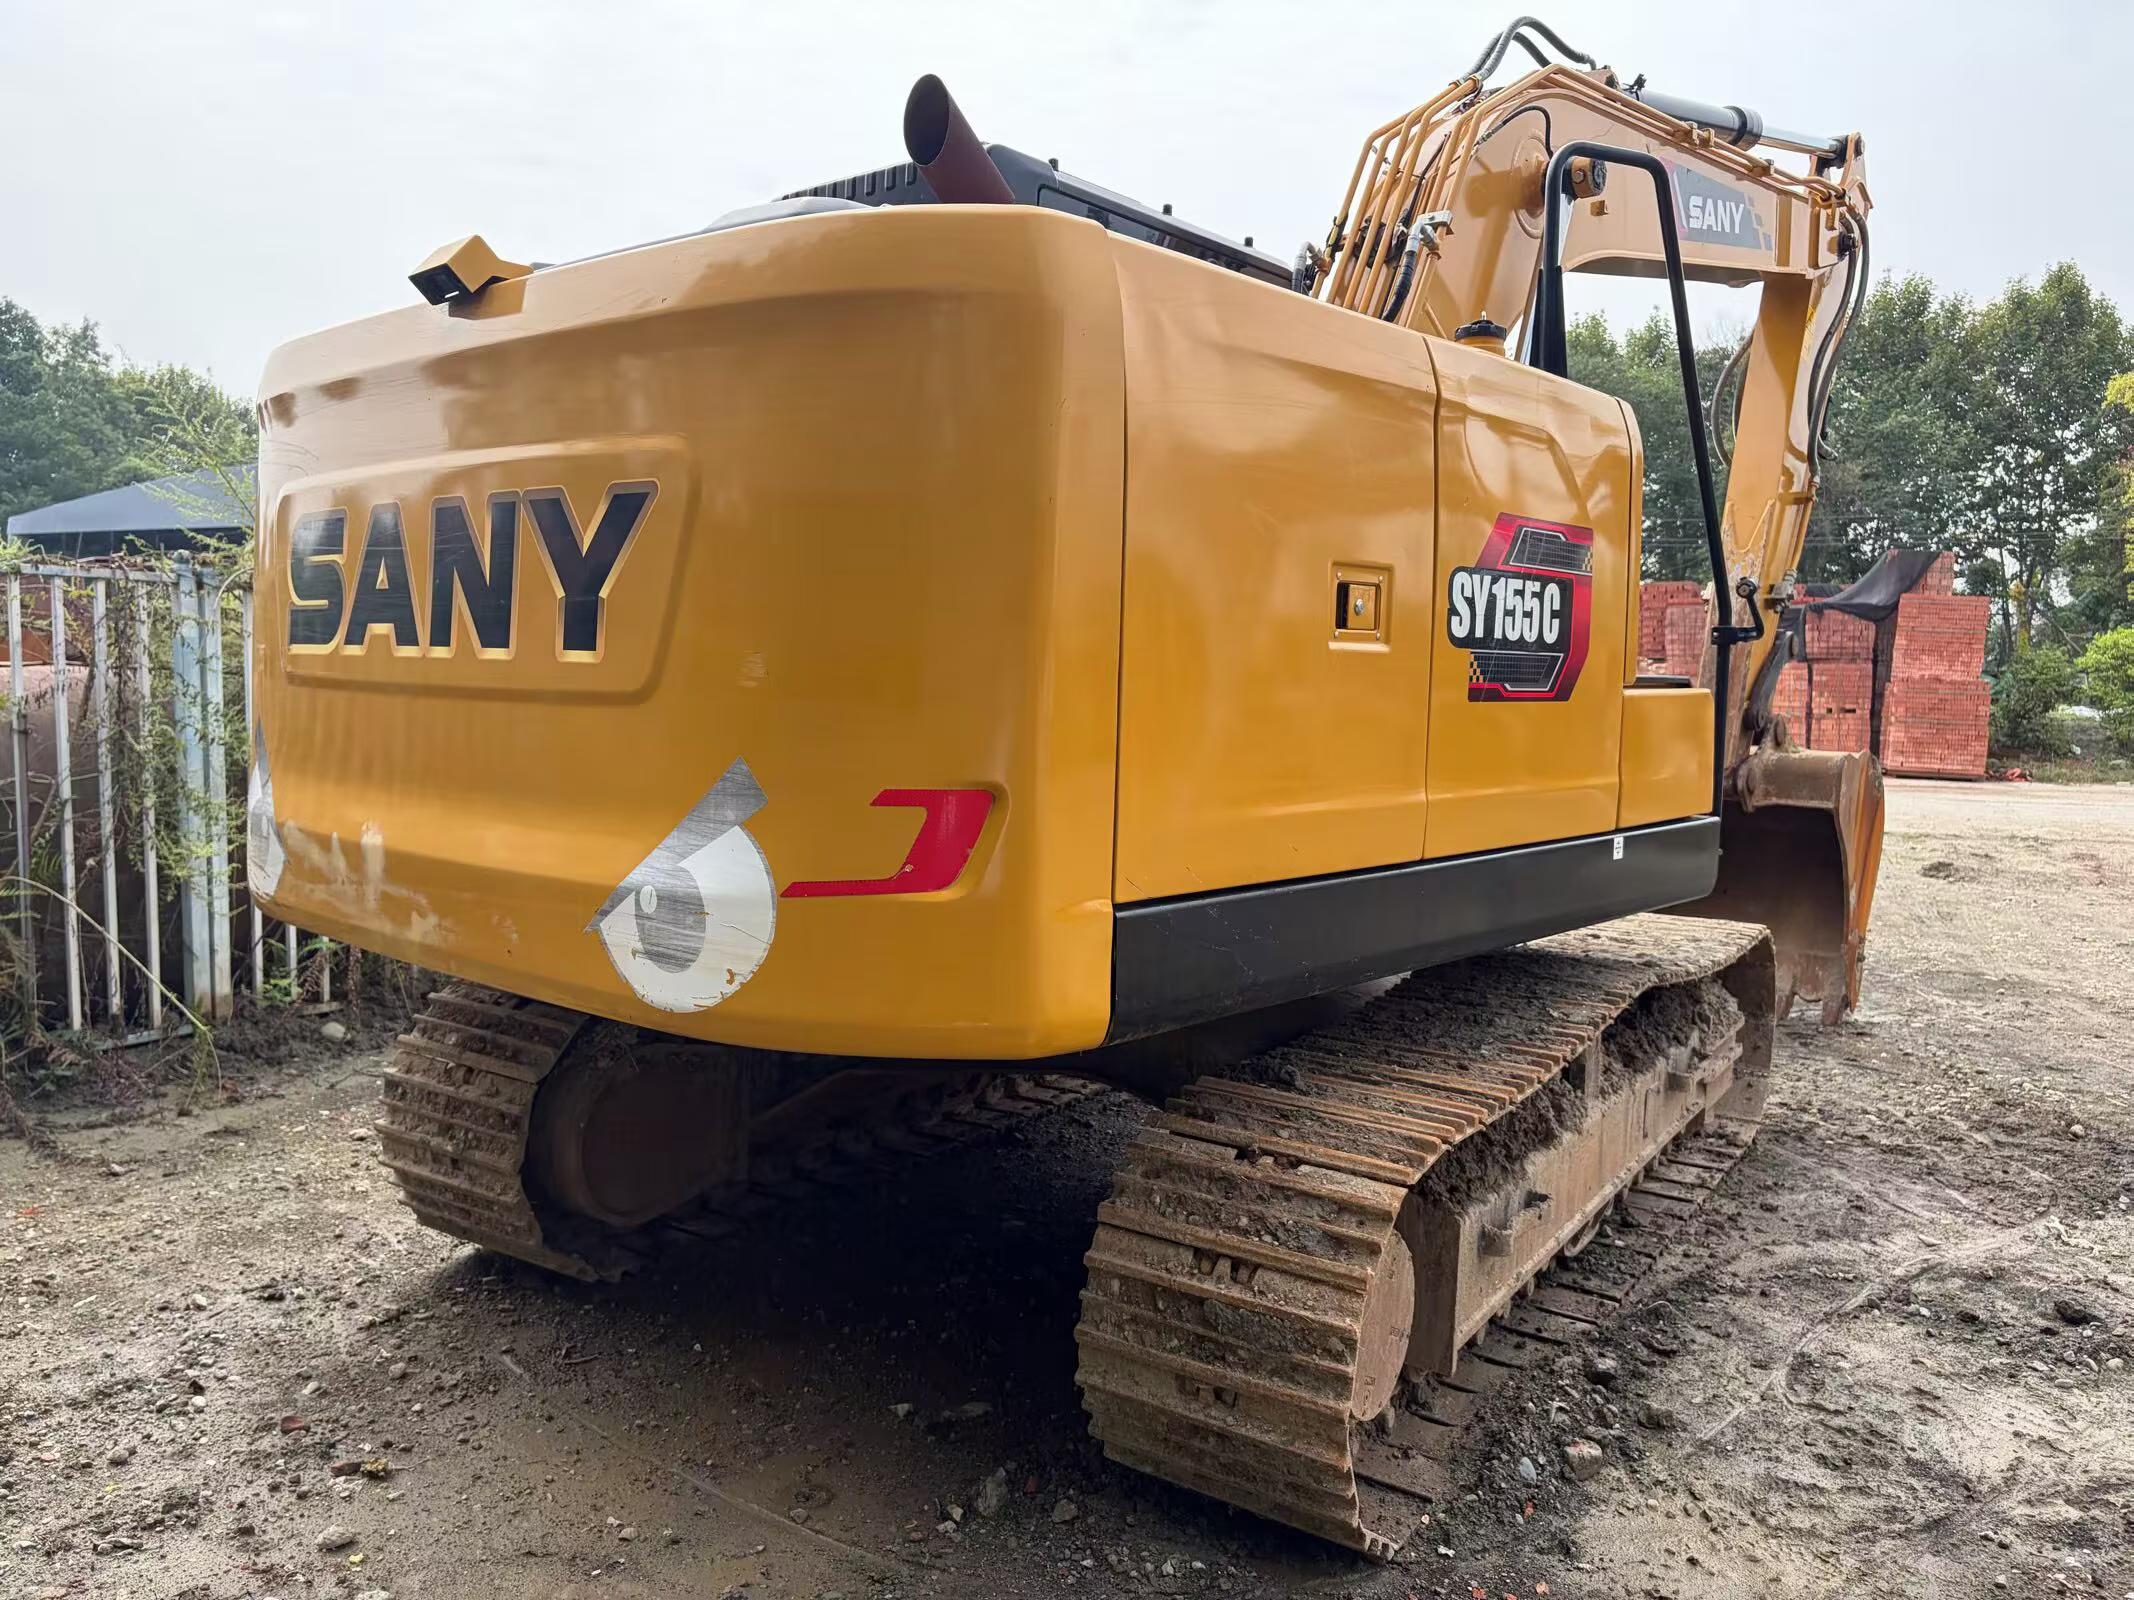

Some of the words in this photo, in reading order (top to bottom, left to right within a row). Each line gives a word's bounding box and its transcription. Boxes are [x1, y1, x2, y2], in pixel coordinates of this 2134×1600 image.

[1688, 195, 1744, 234] SANY
[288, 482, 656, 660] SANY
[1451, 571, 1561, 644] SY155C
